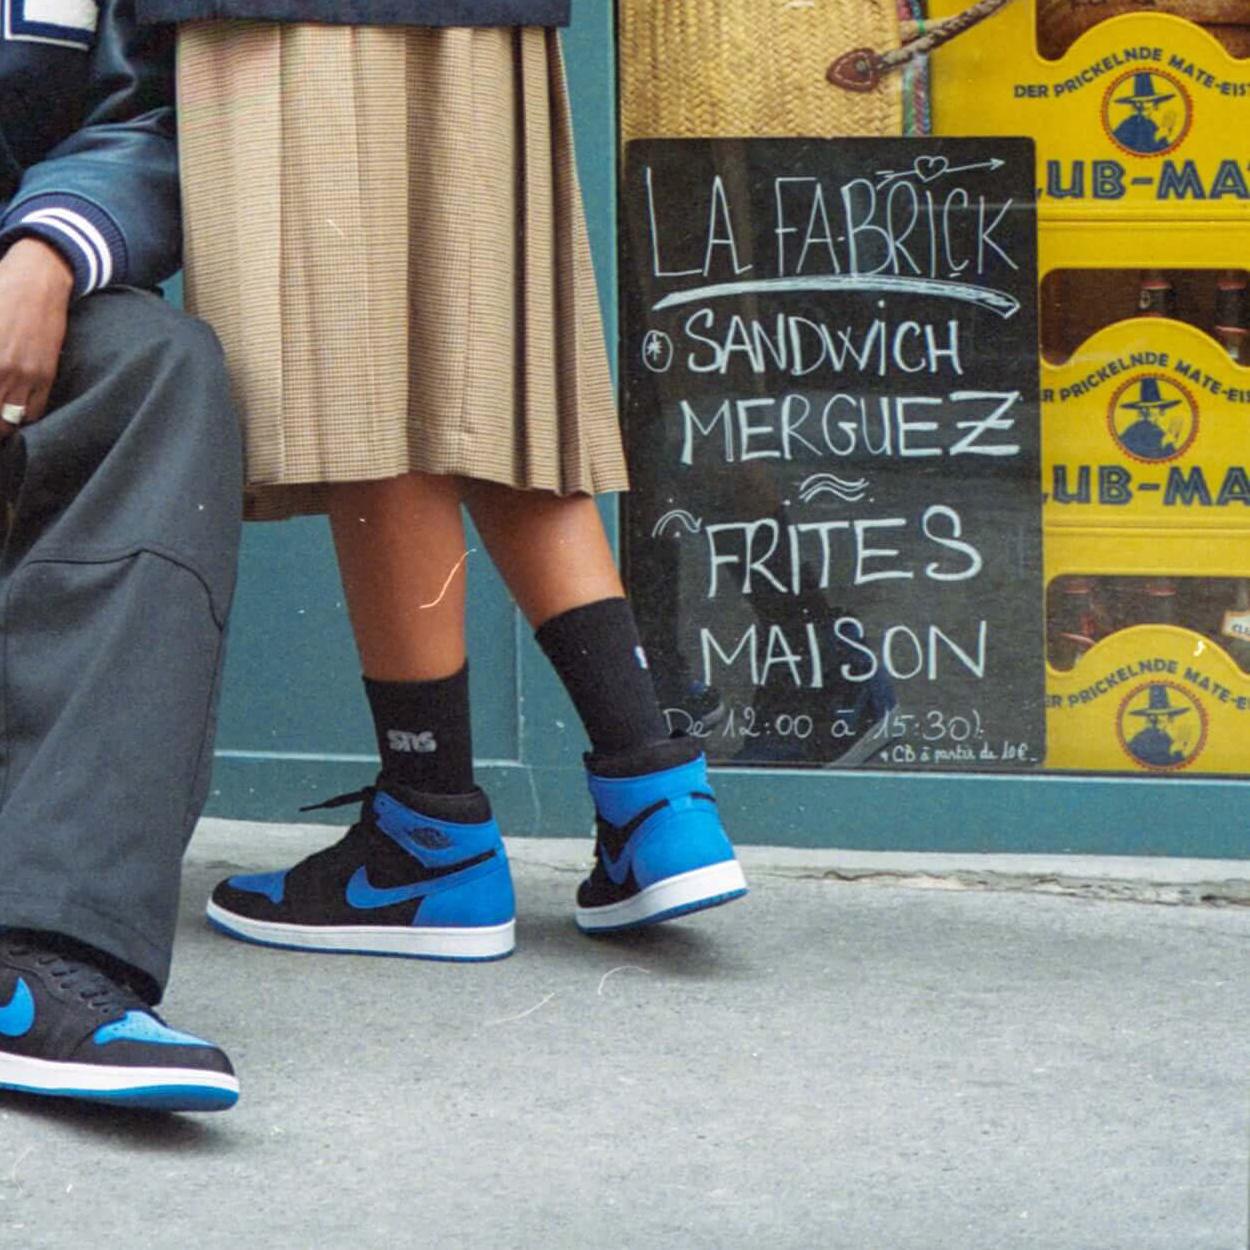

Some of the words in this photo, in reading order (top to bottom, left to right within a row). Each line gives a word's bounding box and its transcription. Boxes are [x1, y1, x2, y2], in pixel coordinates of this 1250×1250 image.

[1014, 83, 1050, 99] DER
[1053, 46, 1163, 99] PRICKELNDE
[1037, 159, 1250, 199] UB-MA
[646, 166, 754, 277] LA
[1060, 351, 1170, 402] PRICKELNDE
[679, 390, 1021, 465] MERGUEZ
[1038, 463, 1250, 507] UB-MA
[705, 504, 983, 599] FRITES
[700, 616, 988, 688] MAISON
[1067, 658, 1179, 709] PRICKELNDE
[1182, 666, 1250, 711] MATE-E
[662, 708, 714, 738] De
[722, 707, 813, 739] 12:00
